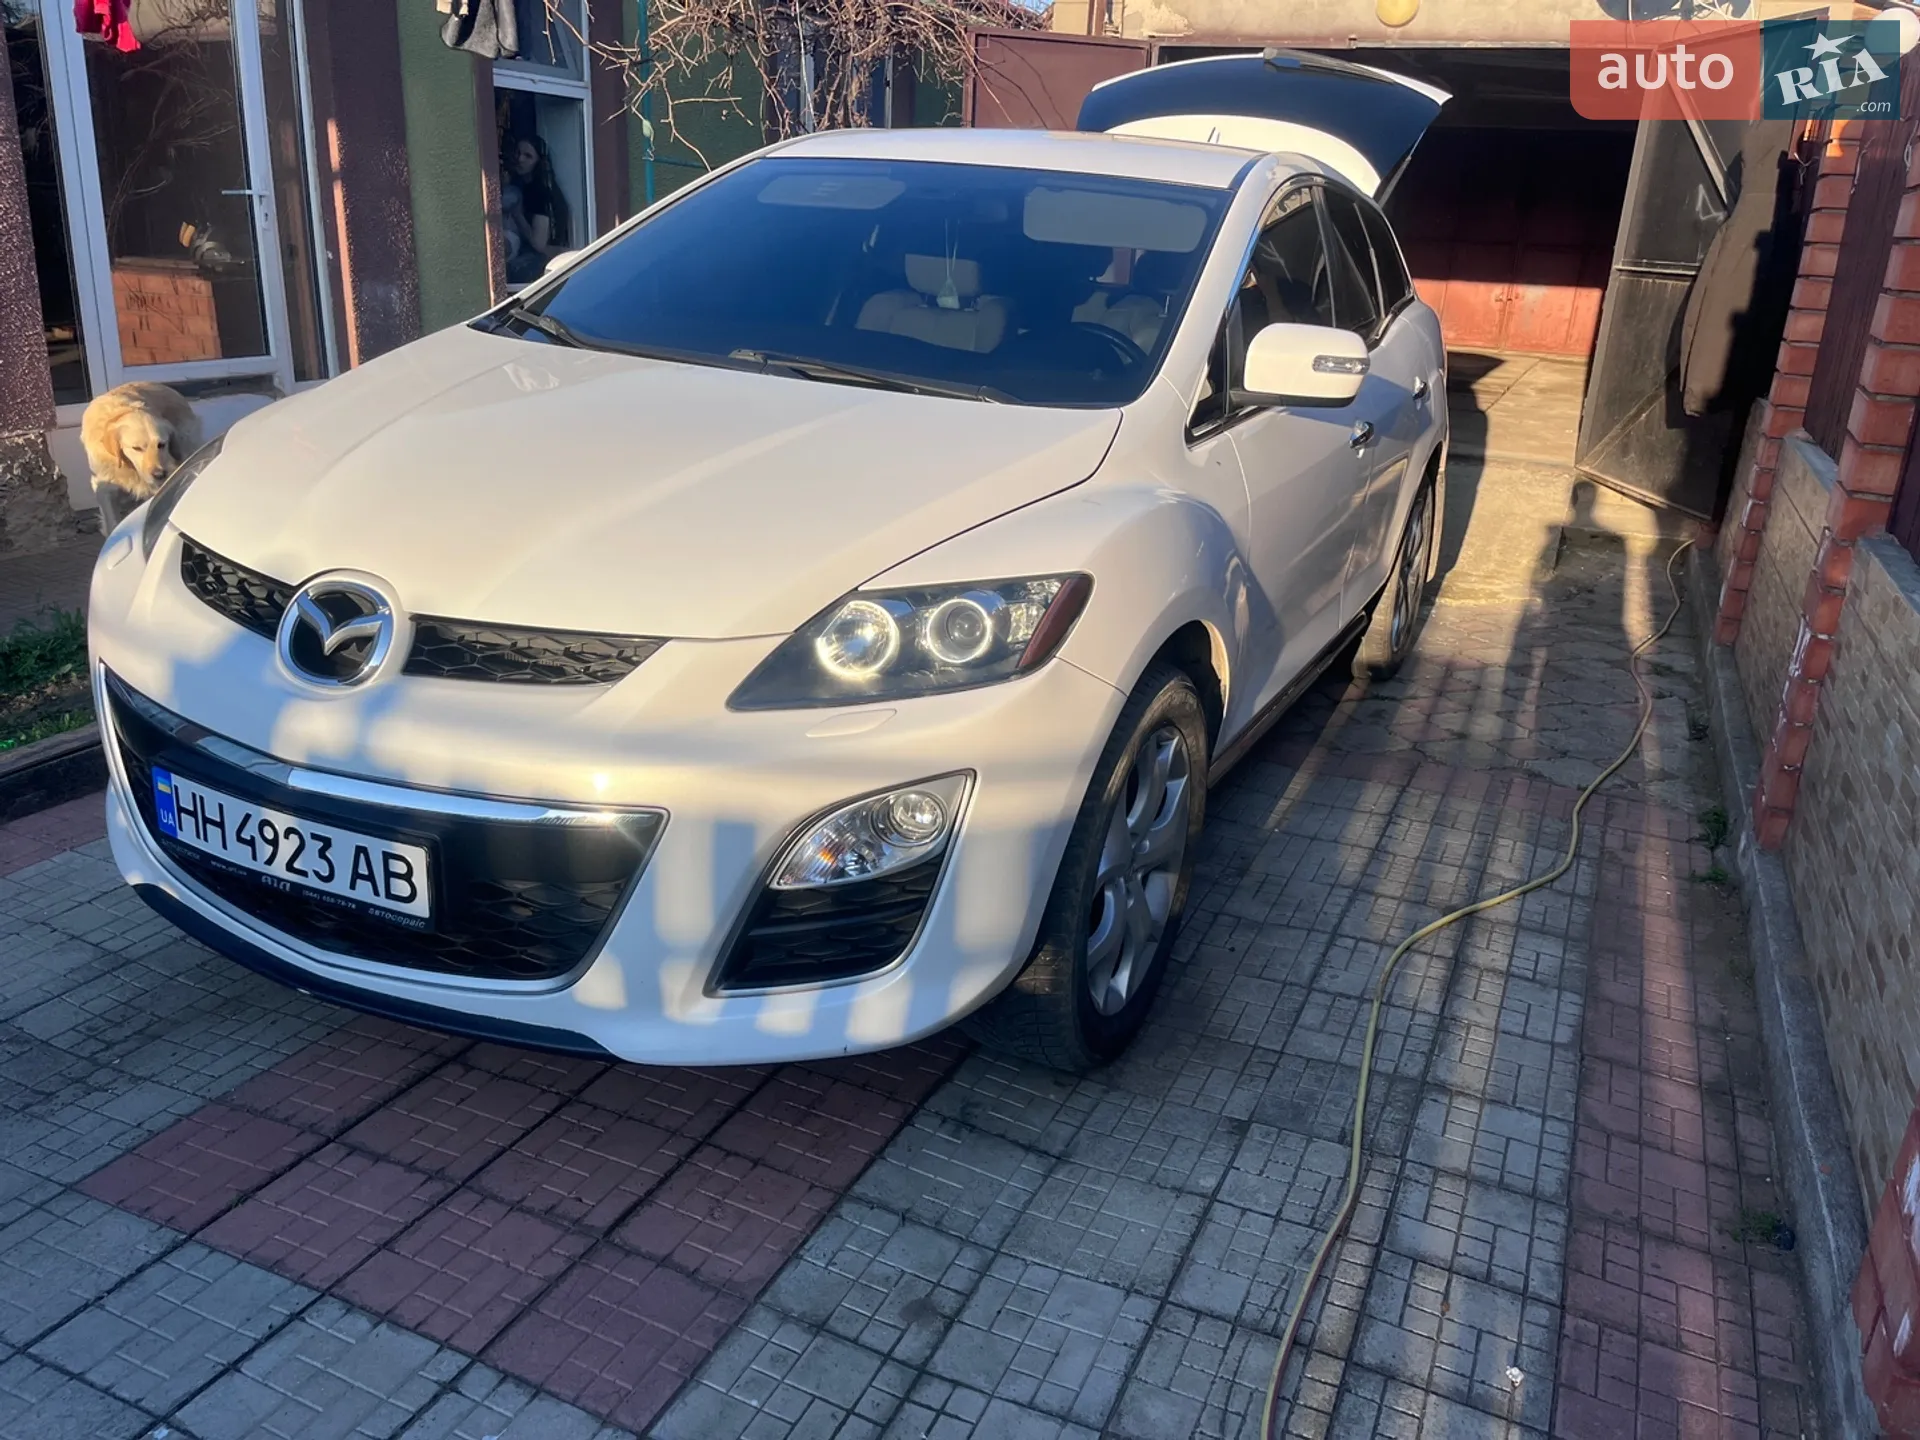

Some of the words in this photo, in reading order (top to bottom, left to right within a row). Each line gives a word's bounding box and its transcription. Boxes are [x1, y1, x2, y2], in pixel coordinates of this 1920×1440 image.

[160, 808, 176, 828] UA
[173, 784, 228, 851] HH
[235, 812, 335, 884] 4923
[349, 844, 418, 904] AB
